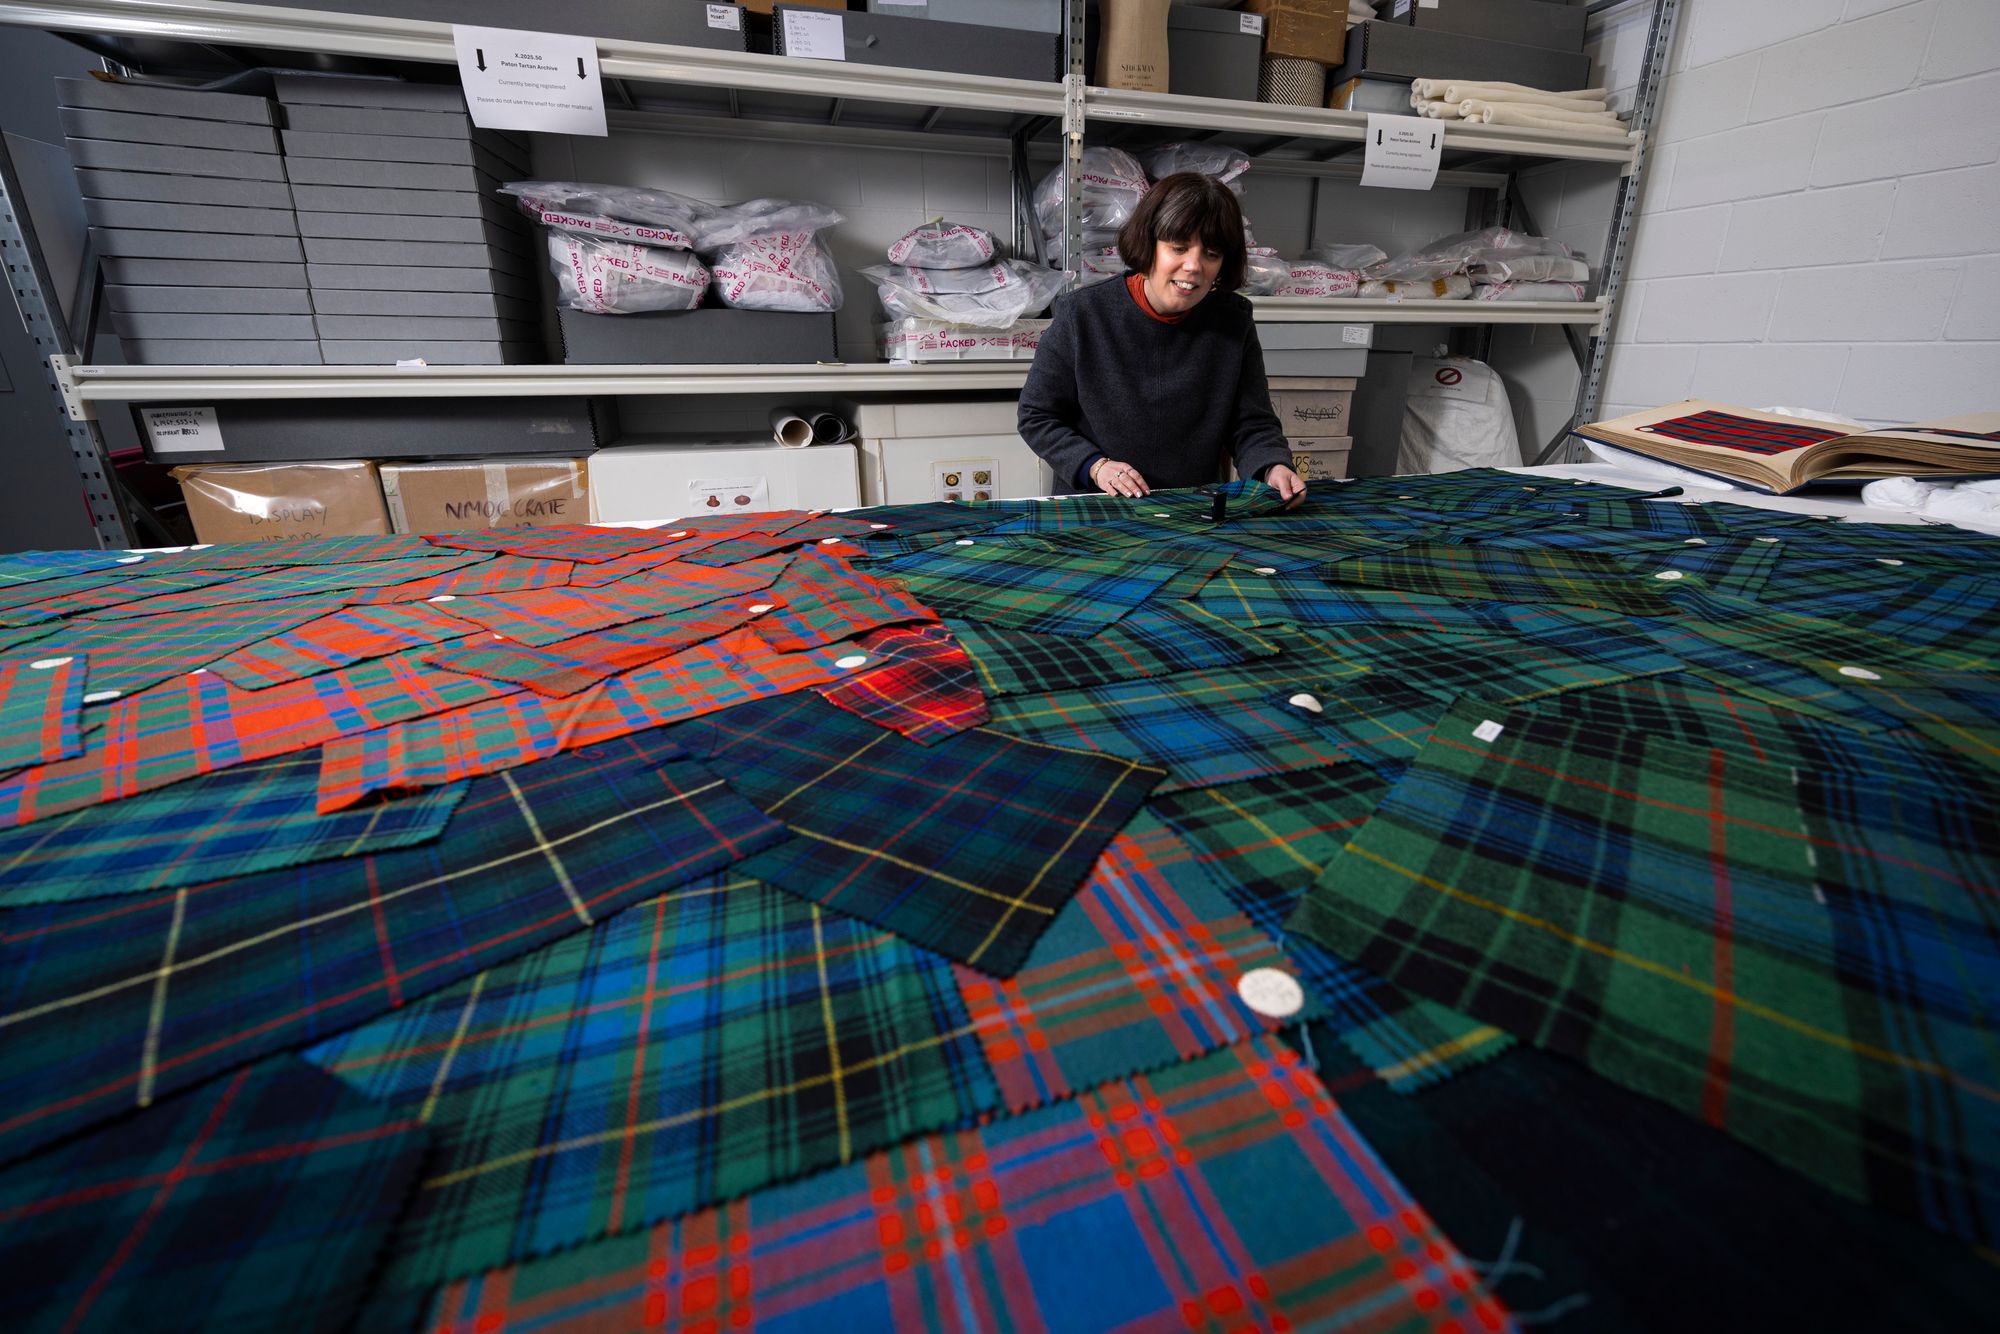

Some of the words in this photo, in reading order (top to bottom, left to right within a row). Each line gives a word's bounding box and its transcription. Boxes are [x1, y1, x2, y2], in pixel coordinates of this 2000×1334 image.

[514, 53, 543, 61] X.2025.50
[518, 62, 537, 70] Tartan
[537, 63, 558, 71] Archive
[498, 79, 524, 88] Currently
[543, 212, 592, 229] PACKED
[635, 227, 680, 243] PACKED
[571, 251, 588, 295] PACKED
[939, 339, 977, 349] PACKED
[514, 498, 568, 518] CRATE
